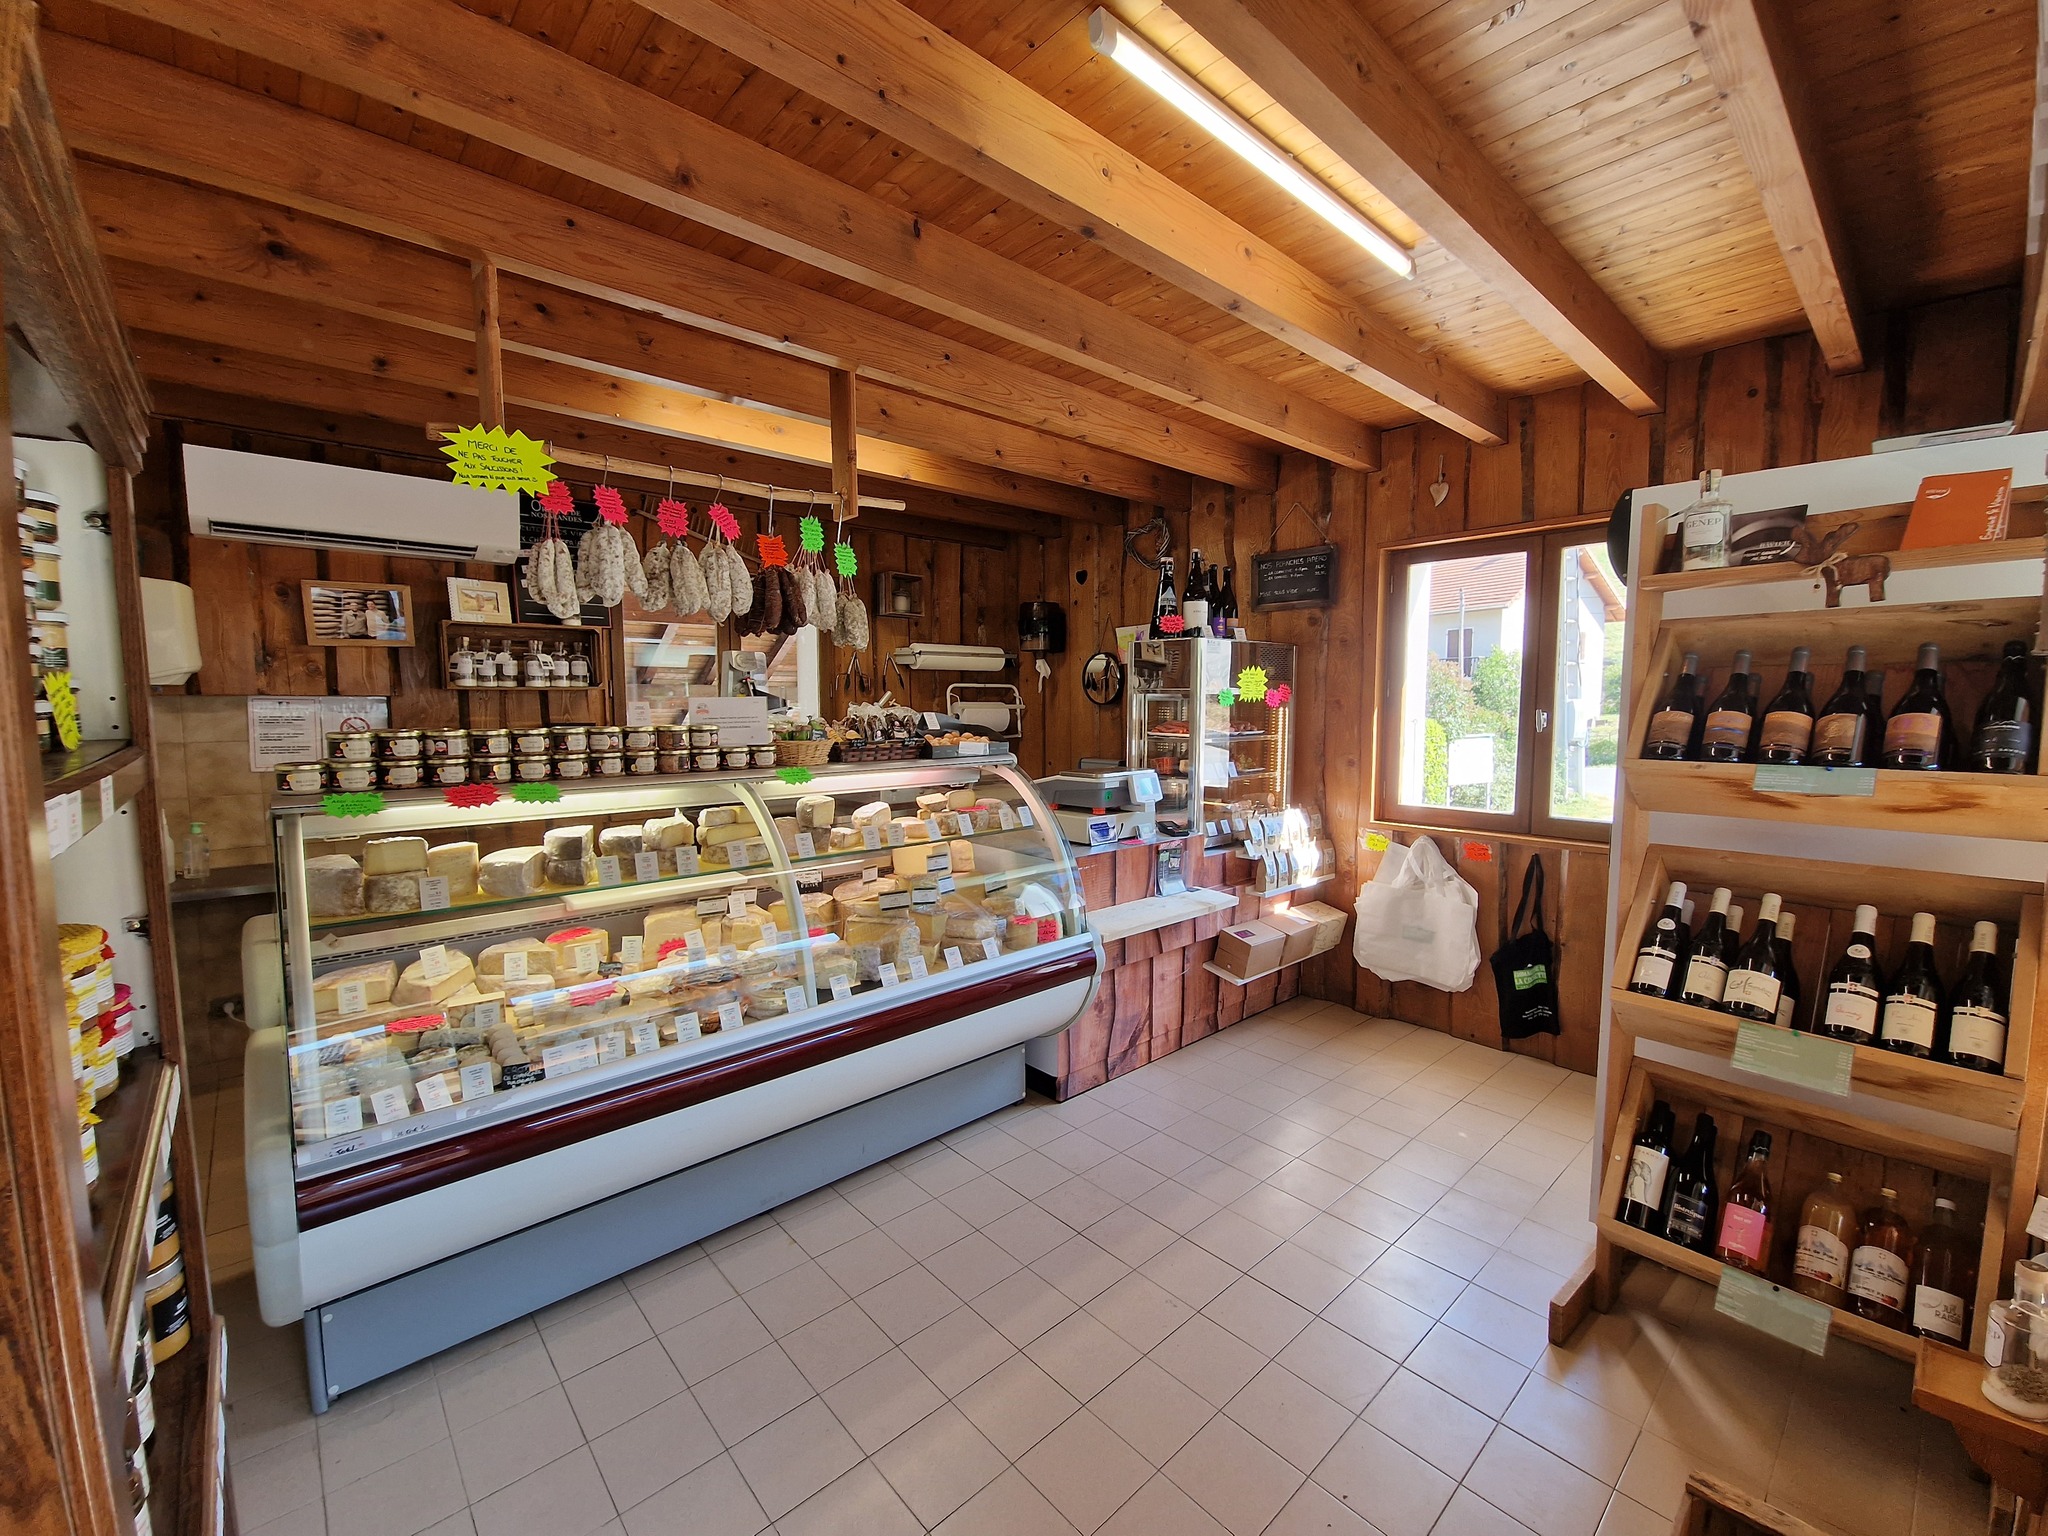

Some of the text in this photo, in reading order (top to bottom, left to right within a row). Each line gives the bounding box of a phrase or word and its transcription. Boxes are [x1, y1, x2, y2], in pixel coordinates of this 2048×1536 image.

[467, 440, 517, 455] MERCI DE
[458, 450, 523, 466] NE PAS TOUCHER
[480, 462, 519, 474] SAUCISSONS
